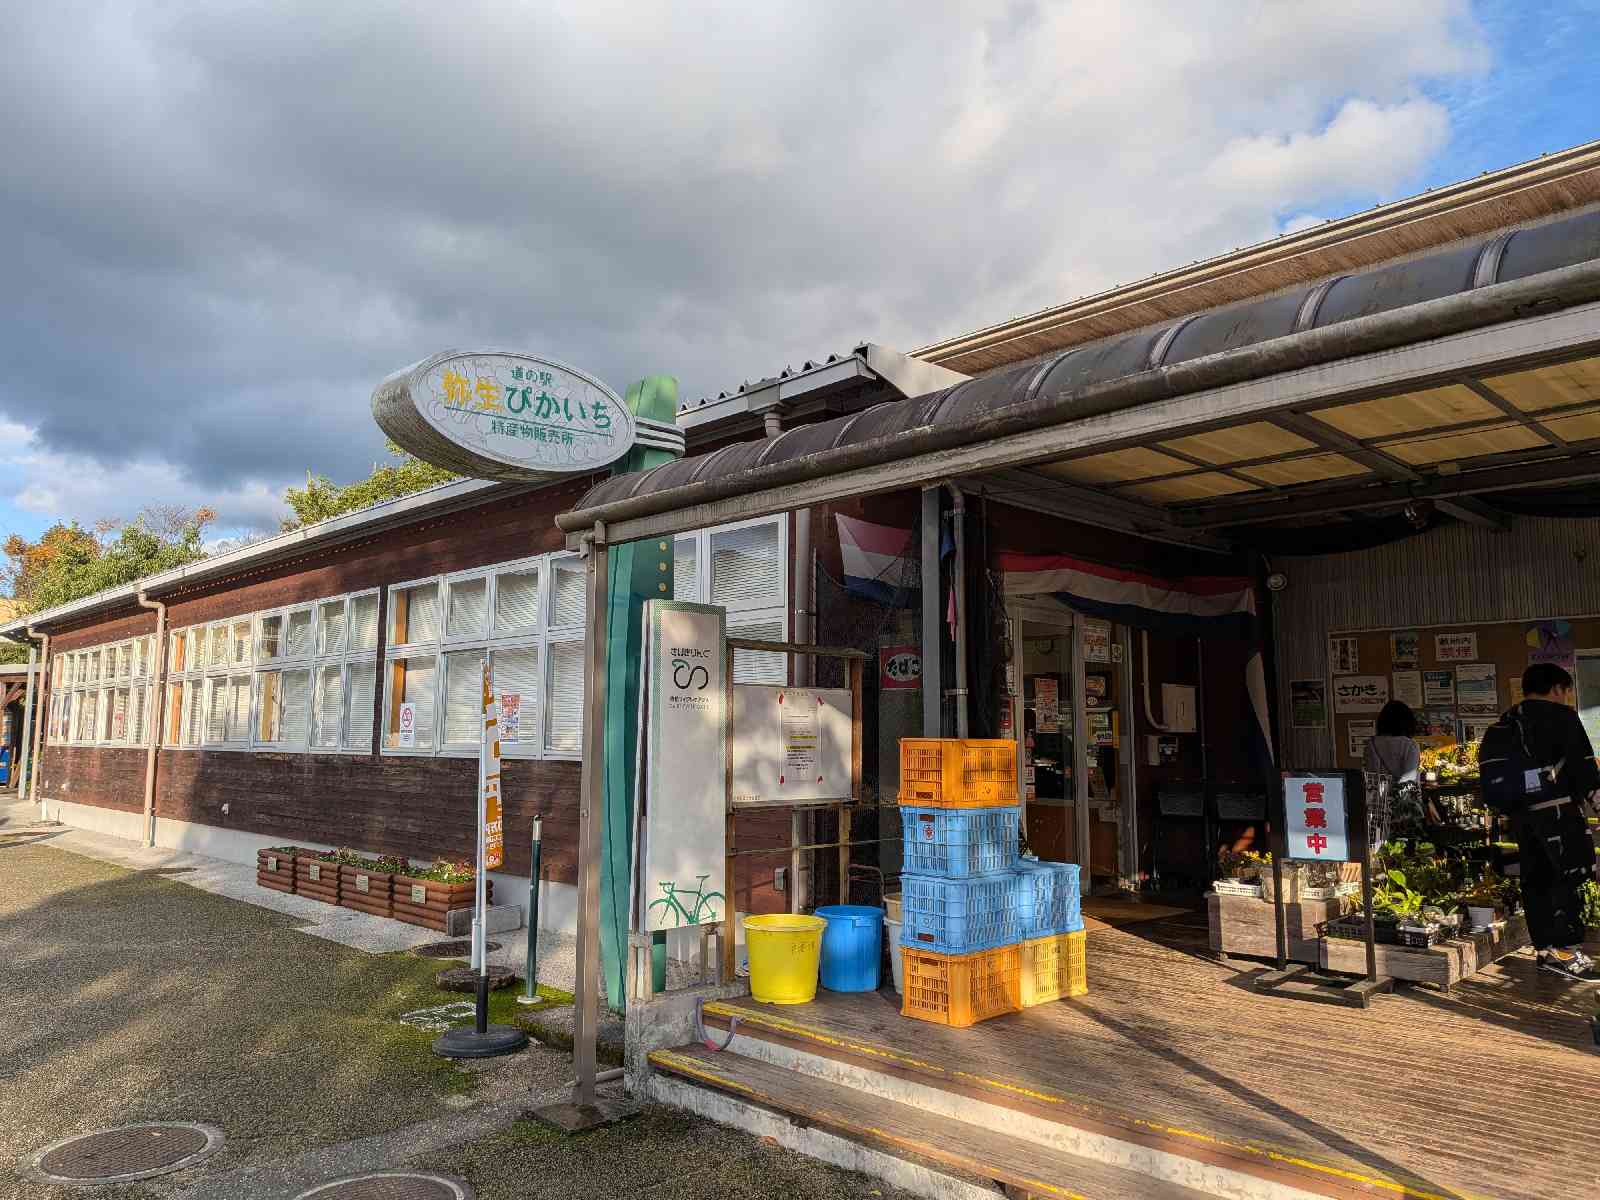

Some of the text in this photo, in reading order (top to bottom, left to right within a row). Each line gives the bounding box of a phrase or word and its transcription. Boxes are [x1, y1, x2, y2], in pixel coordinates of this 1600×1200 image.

[510, 365, 552, 387] 道の駅
[443, 369, 613, 430] 弥生 ぴかいち
[491, 420, 575, 446] 特産物販売所
[886, 656, 921, 677] たばこ
[1302, 781, 1328, 855] 営業中
